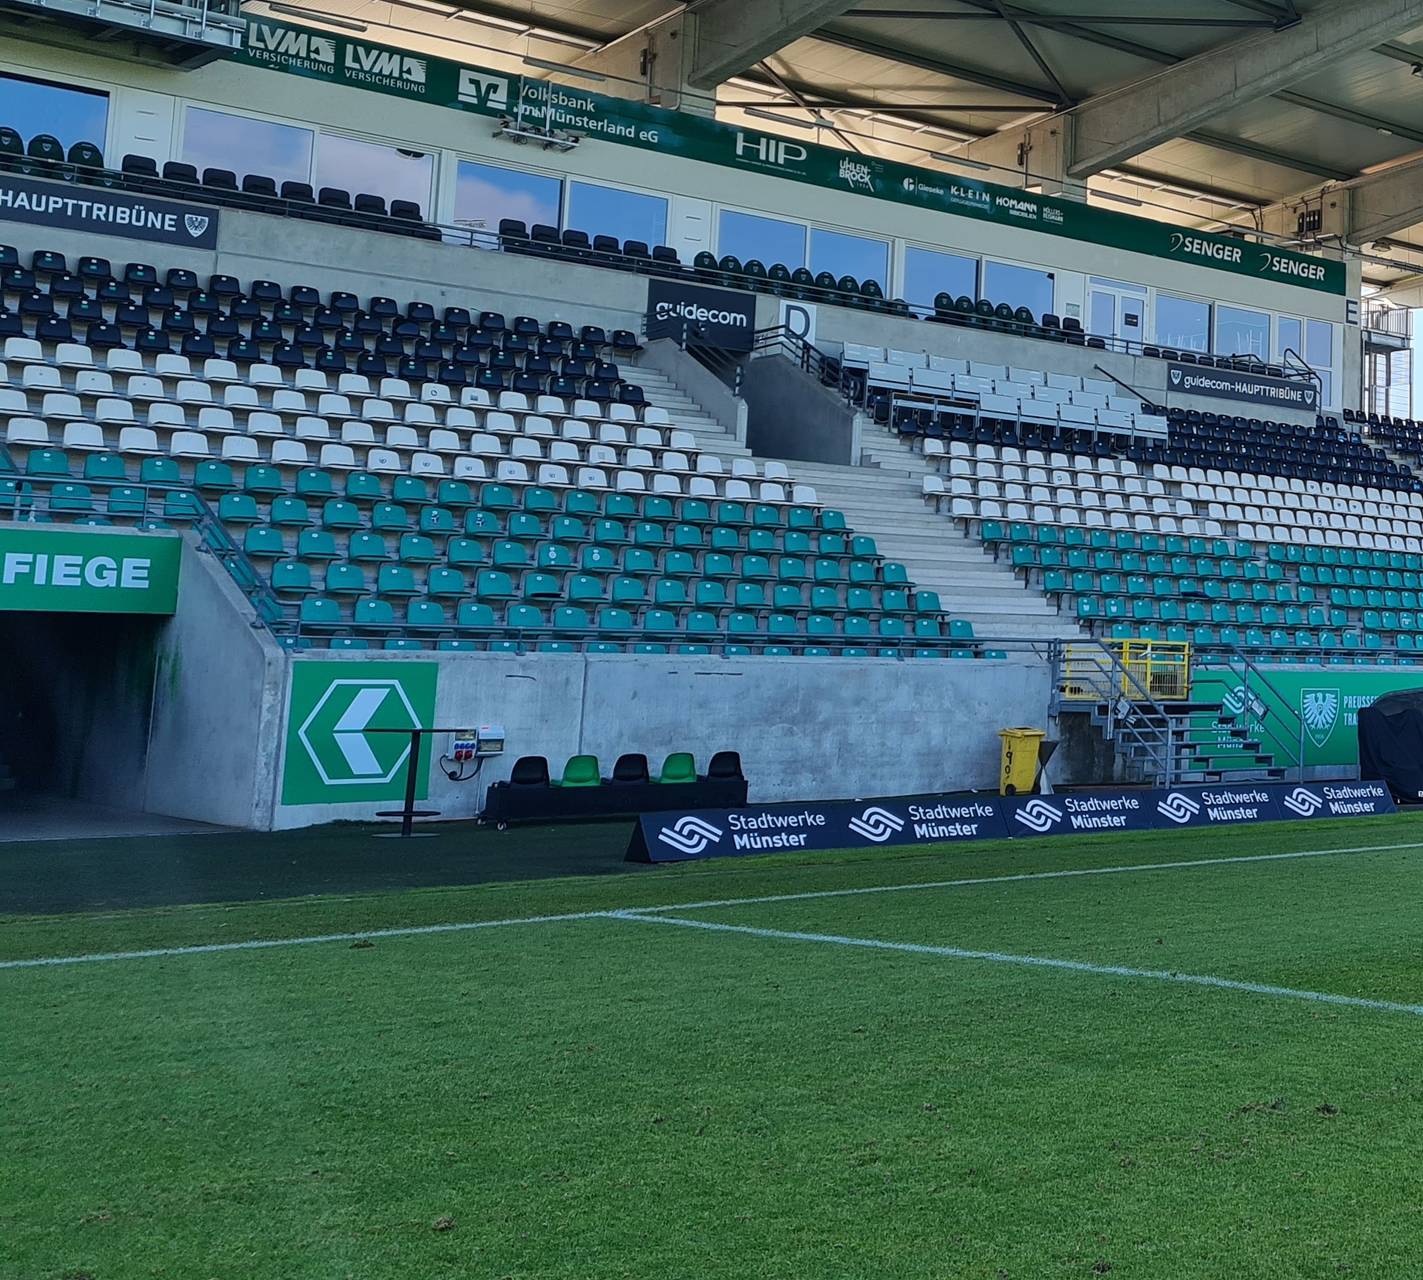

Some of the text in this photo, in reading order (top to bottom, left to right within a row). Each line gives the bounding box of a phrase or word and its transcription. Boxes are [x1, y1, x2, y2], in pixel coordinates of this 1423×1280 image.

[248, 22, 308, 58] LVM
[248, 48, 336, 75] VERSICHERUNG
[344, 44, 400, 77] LVM
[344, 69, 426, 94] VERSICHERUNG
[638, 129, 659, 144] eG
[735, 131, 808, 166] HIP
[839, 169, 875, 193] BROCK
[950, 185, 990, 203] KLEIN
[996, 195, 1038, 213] HOMANN
[0, 188, 178, 232] HAUPTTRIBÜNE
[1184, 236, 1242, 264] SENGER
[1271, 256, 1326, 281] SENGER
[655, 301, 748, 328] guidecom
[785, 304, 811, 340] D
[1345, 299, 1359, 326] E
[1183, 375, 1303, 402] guidecom-HAUPTTRIBÜNE
[2, 552, 152, 589] FIEGE
[1343, 695, 1379, 709] PREUSSE
[1201, 790, 1270, 806] Stadtwerke
[1322, 785, 1385, 800] Stadtwerke
[908, 802, 994, 821] Stadtwerke
[1064, 796, 1140, 813] Stadtwerke
[1206, 806, 1259, 821] Münster
[1328, 800, 1375, 815] Münster
[727, 811, 826, 831] Stadtwerke
[913, 821, 979, 839] Münster
[1070, 813, 1127, 830] Münster
[732, 831, 808, 850] Münster
